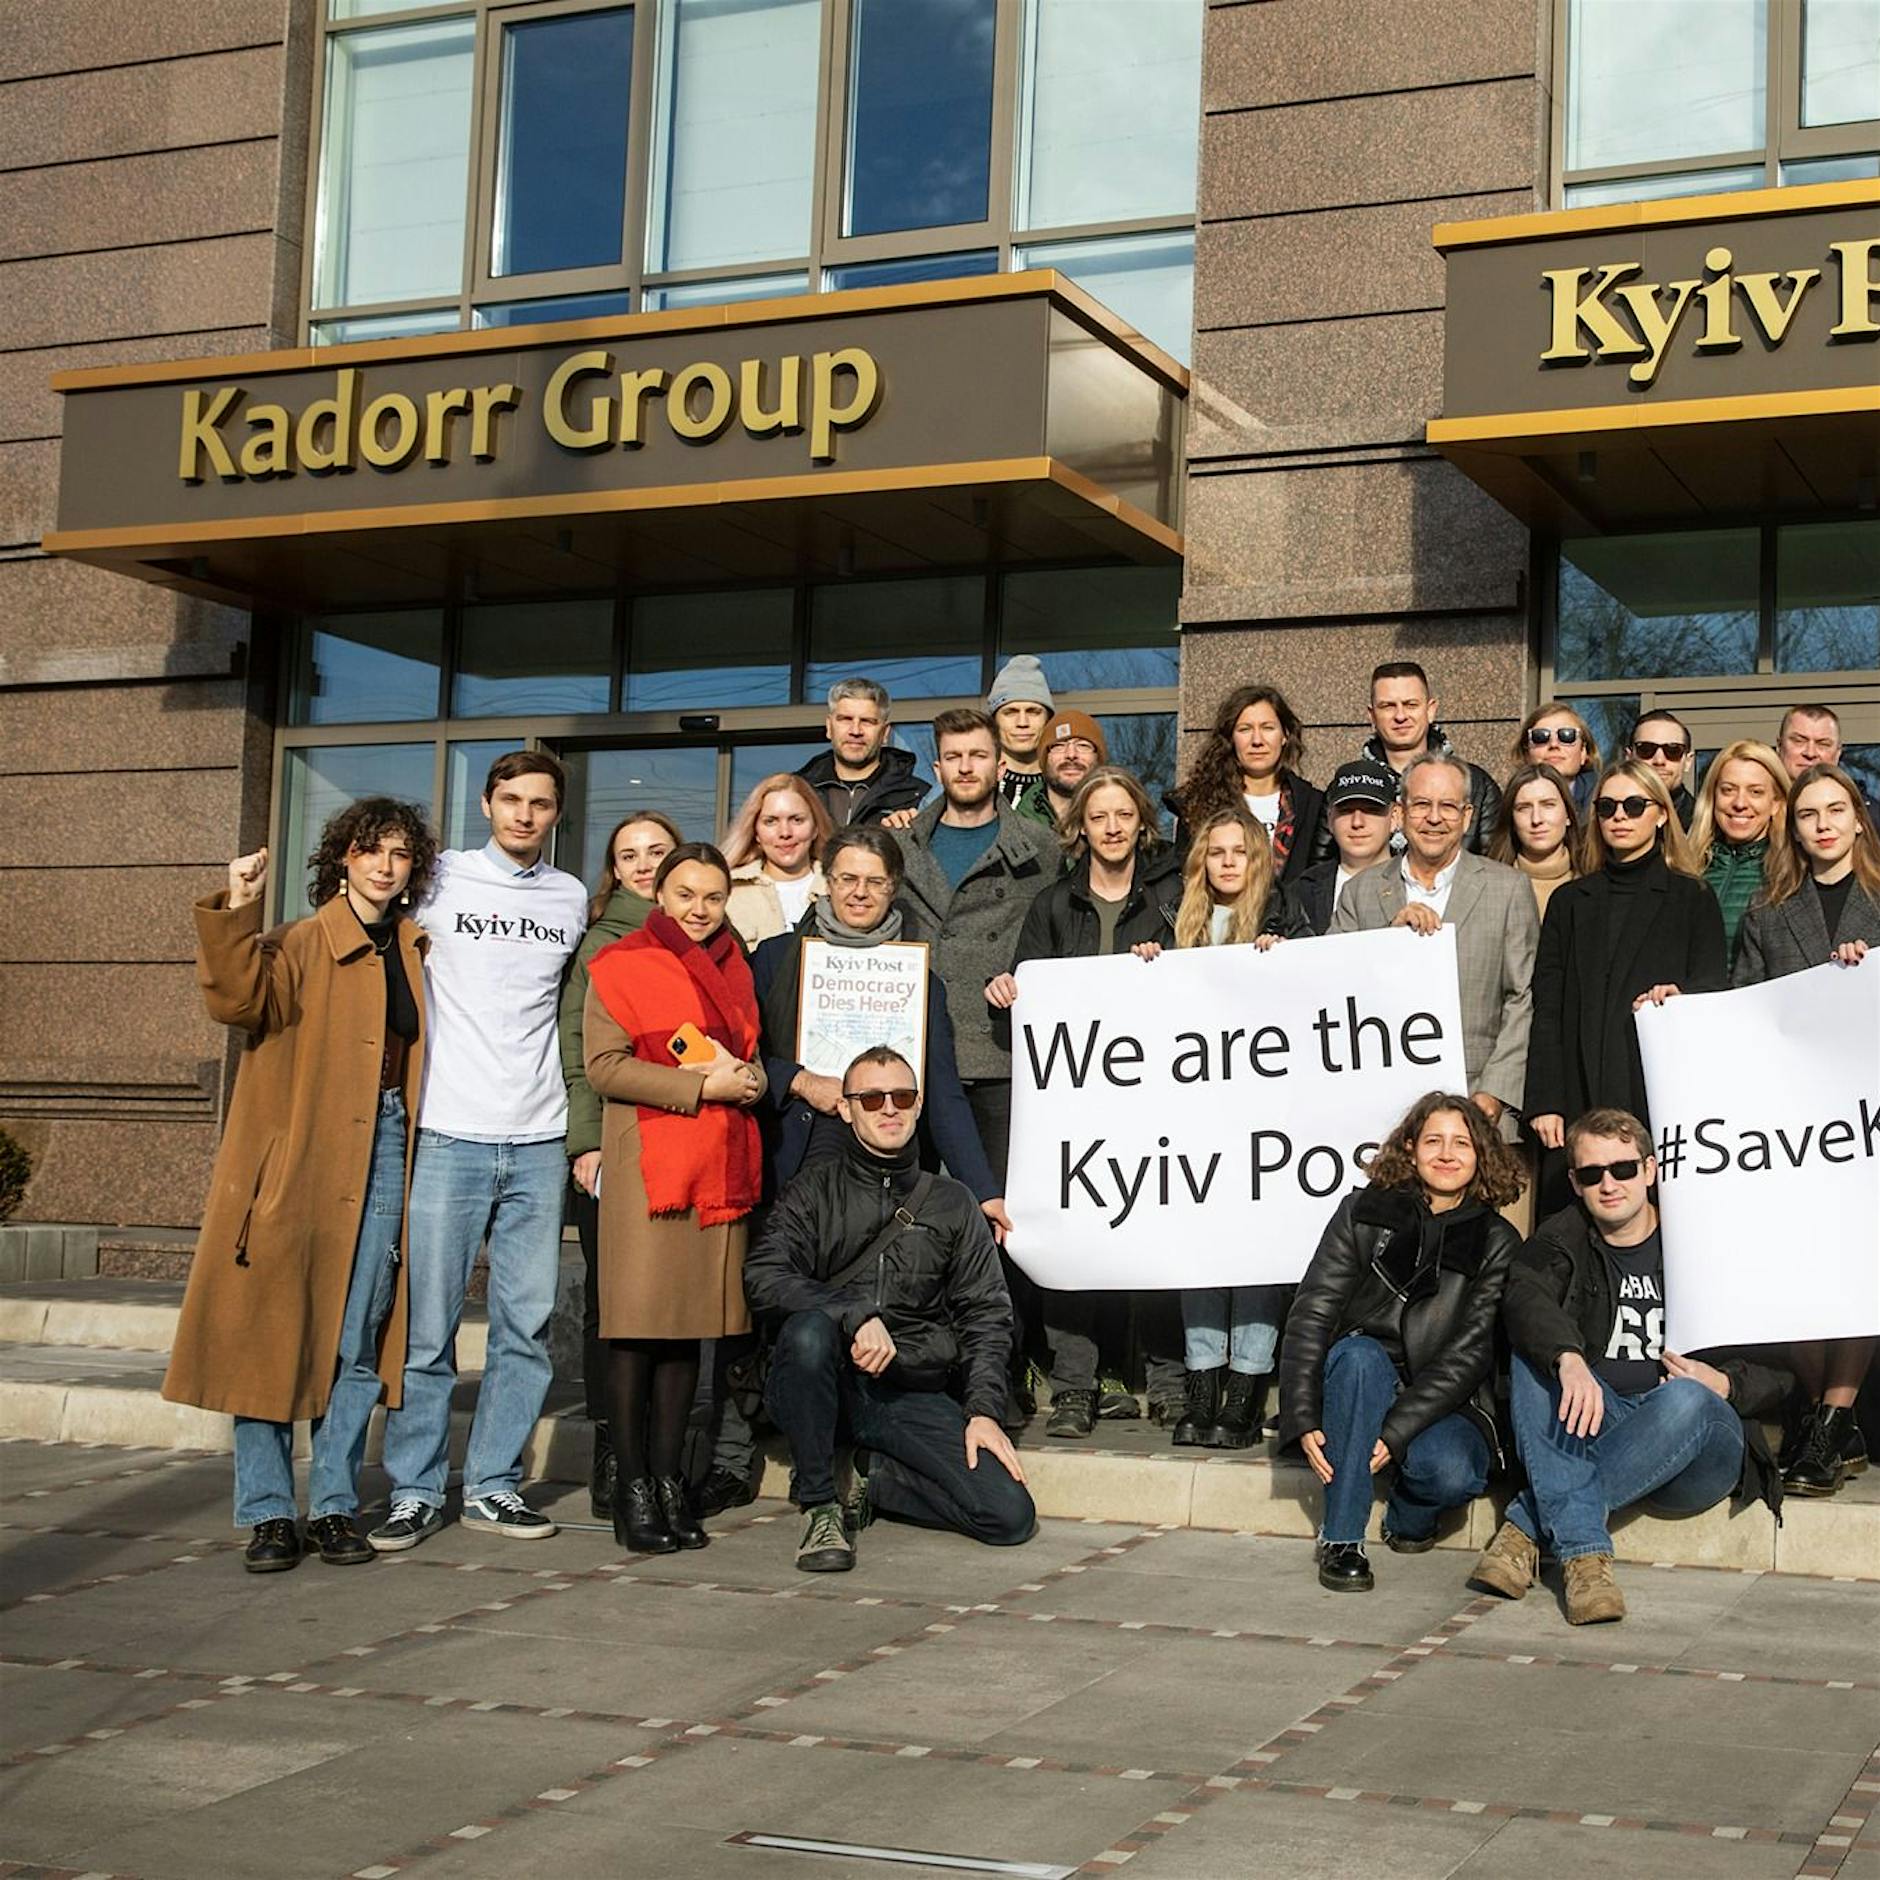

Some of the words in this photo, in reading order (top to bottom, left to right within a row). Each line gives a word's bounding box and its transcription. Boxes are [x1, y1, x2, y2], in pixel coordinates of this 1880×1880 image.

[1540, 247, 1821, 383] Kyiv
[178, 367, 520, 483] Kadorr
[542, 344, 880, 463] Group
[454, 912, 515, 940] Kyiv
[518, 917, 566, 945] Post
[826, 955, 864, 973] Kyiv
[867, 957, 904, 973] Post
[812, 974, 916, 998] Democracy
[818, 994, 856, 1011] Dies
[859, 995, 908, 1013] Here?
[1023, 1020, 1144, 1090] We
[1171, 1025, 1290, 1083] are
[1312, 996, 1444, 1073] the
[1060, 1136, 1222, 1229] Kyiv
[1619, 1273, 1662, 1301] ABA
